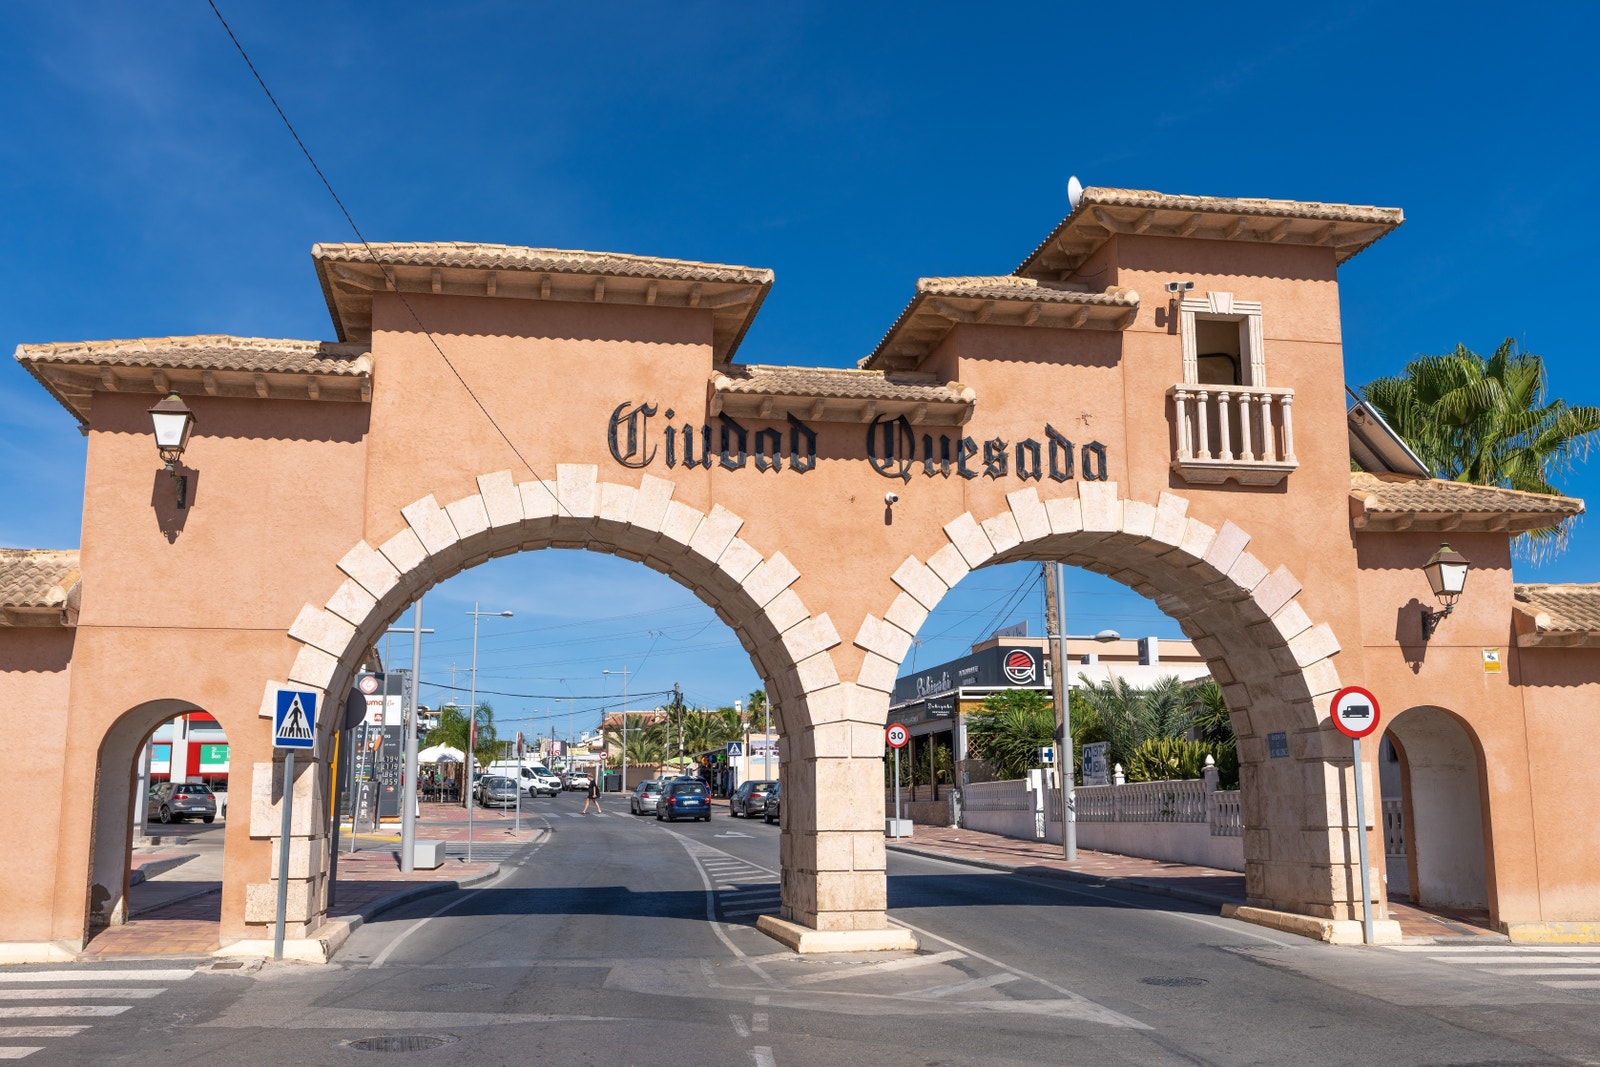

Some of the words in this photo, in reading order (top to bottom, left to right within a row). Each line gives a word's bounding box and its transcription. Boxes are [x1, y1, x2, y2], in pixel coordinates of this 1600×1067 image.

[607, 400, 818, 474] Ciudad
[866, 412, 1109, 485] Quesada
[890, 731, 904, 740] 30
[360, 784, 370, 819] AIRE
